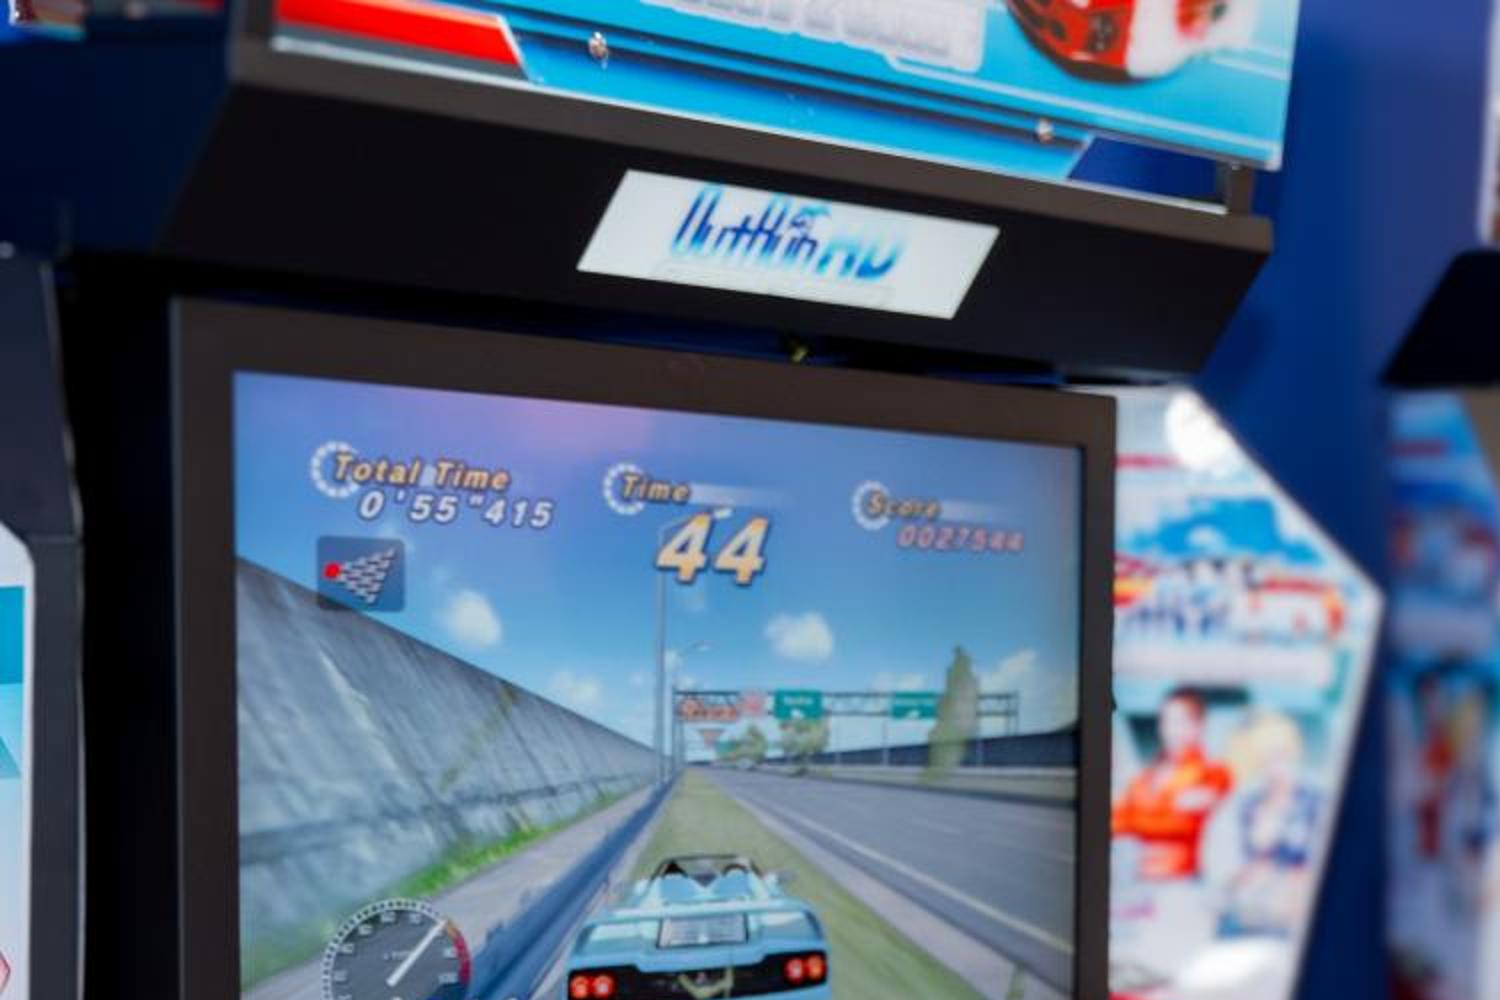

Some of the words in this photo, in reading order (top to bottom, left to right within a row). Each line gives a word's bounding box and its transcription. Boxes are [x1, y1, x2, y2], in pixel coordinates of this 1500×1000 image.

[333, 453, 420, 483] Total
[436, 461, 510, 490] Time
[621, 473, 690, 502] Time
[655, 511, 769, 586] 44
